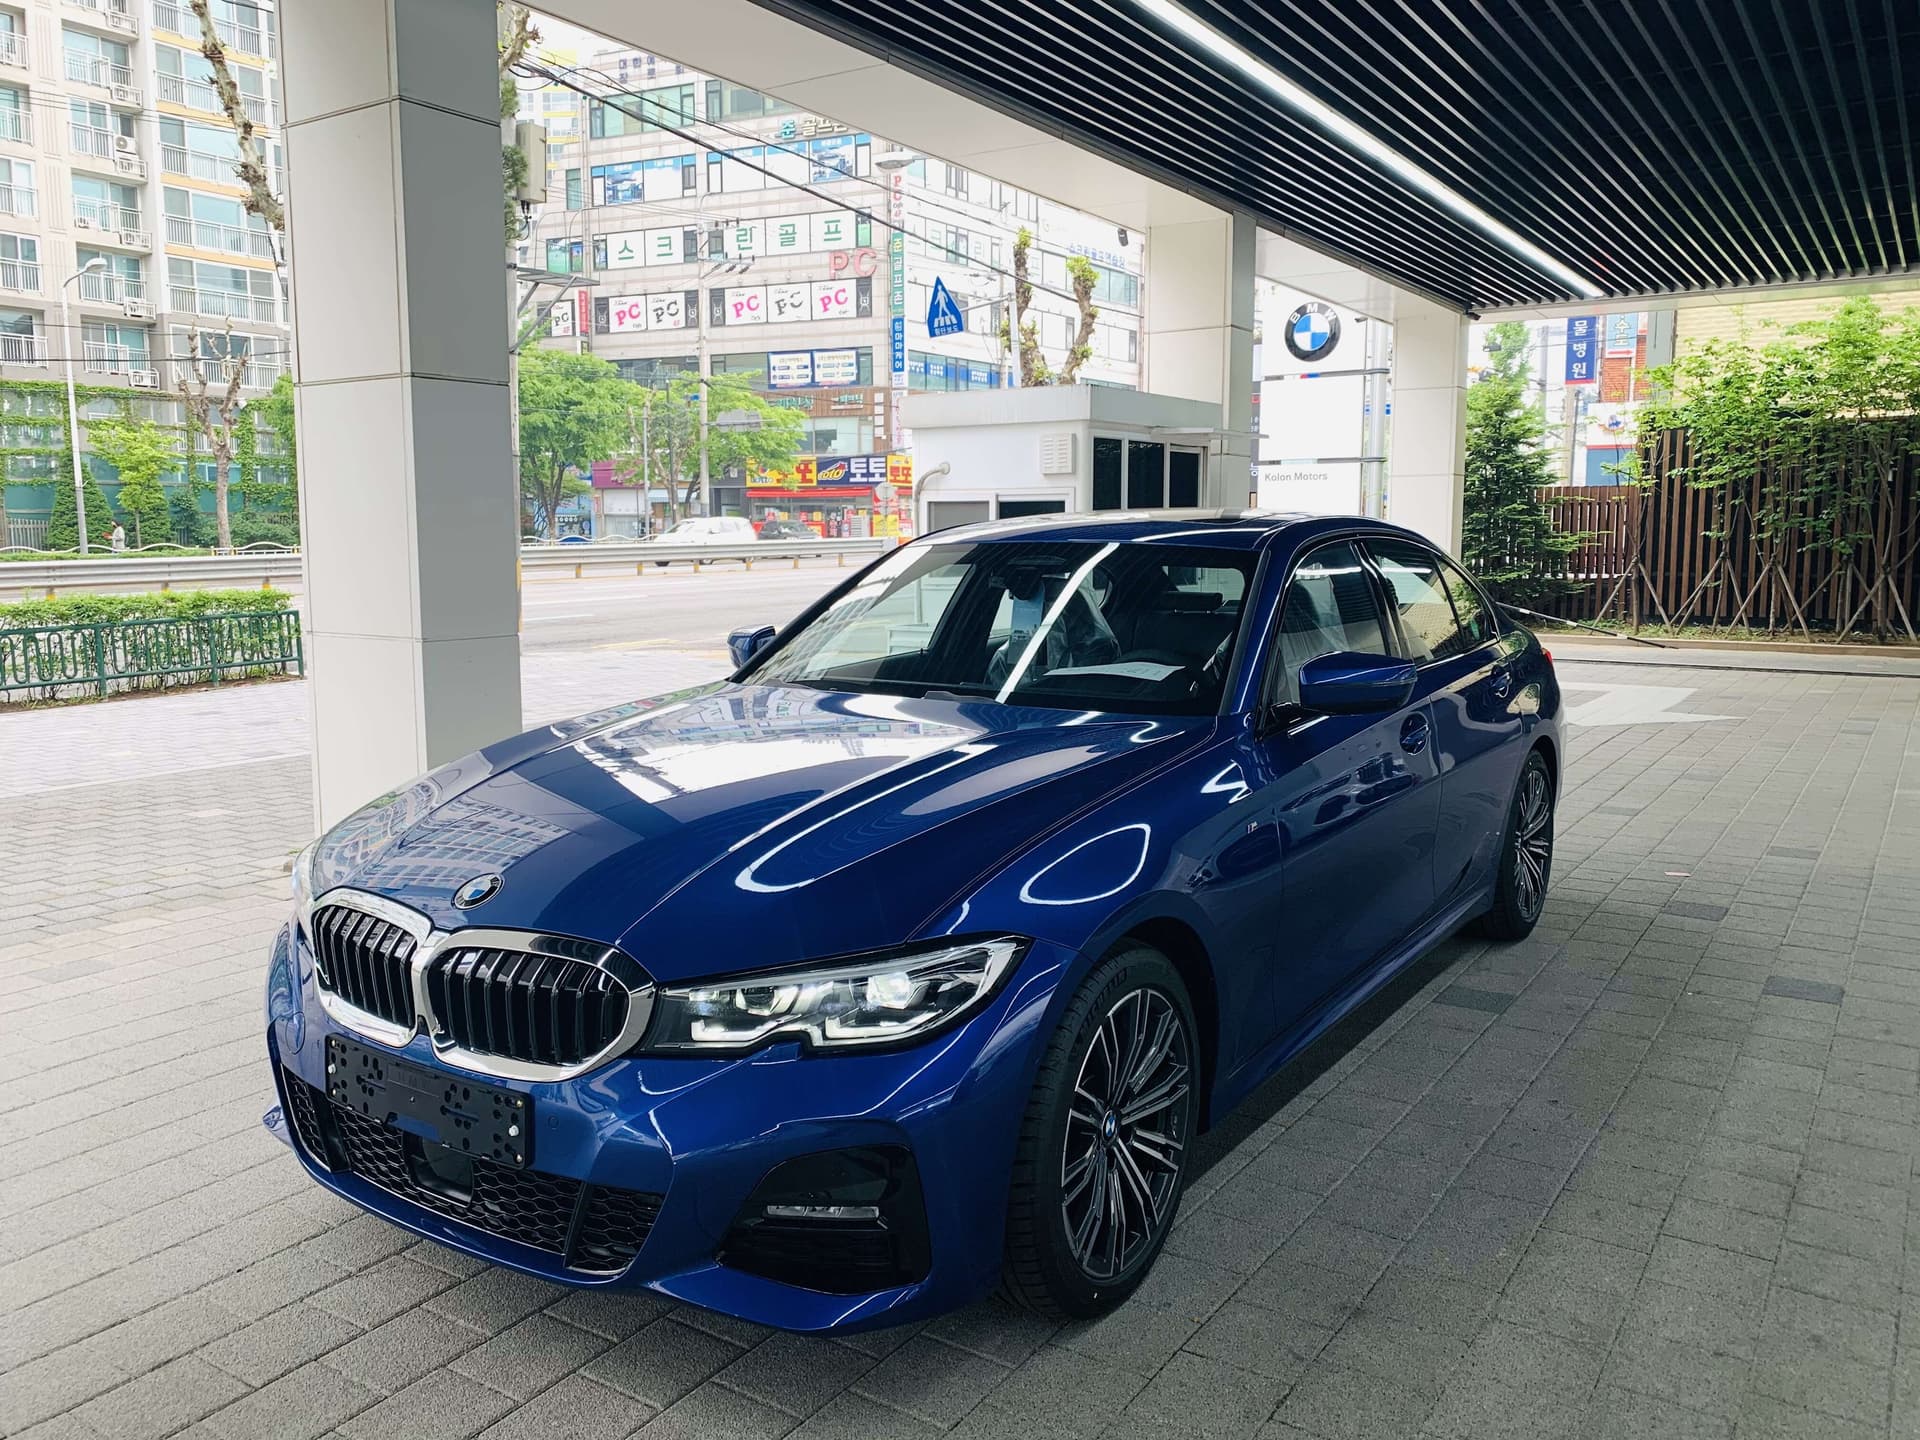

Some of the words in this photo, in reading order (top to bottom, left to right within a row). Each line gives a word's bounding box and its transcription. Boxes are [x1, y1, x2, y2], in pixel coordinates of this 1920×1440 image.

[829, 247, 877, 281] PC
[652, 300, 680, 324] PC
[732, 294, 760, 319] PC
[774, 291, 804, 316] PC
[820, 287, 849, 313] PC
[554, 312, 570, 327] PC
[615, 303, 642, 327] PC
[1290, 302, 1337, 324] BMW
[934, 324, 959, 337] 횡단보도
[1571, 319, 1589, 379] 물병원
[849, 457, 887, 483] 토토
[1264, 467, 1292, 481] Kolon
[1294, 466, 1328, 481] Motors
